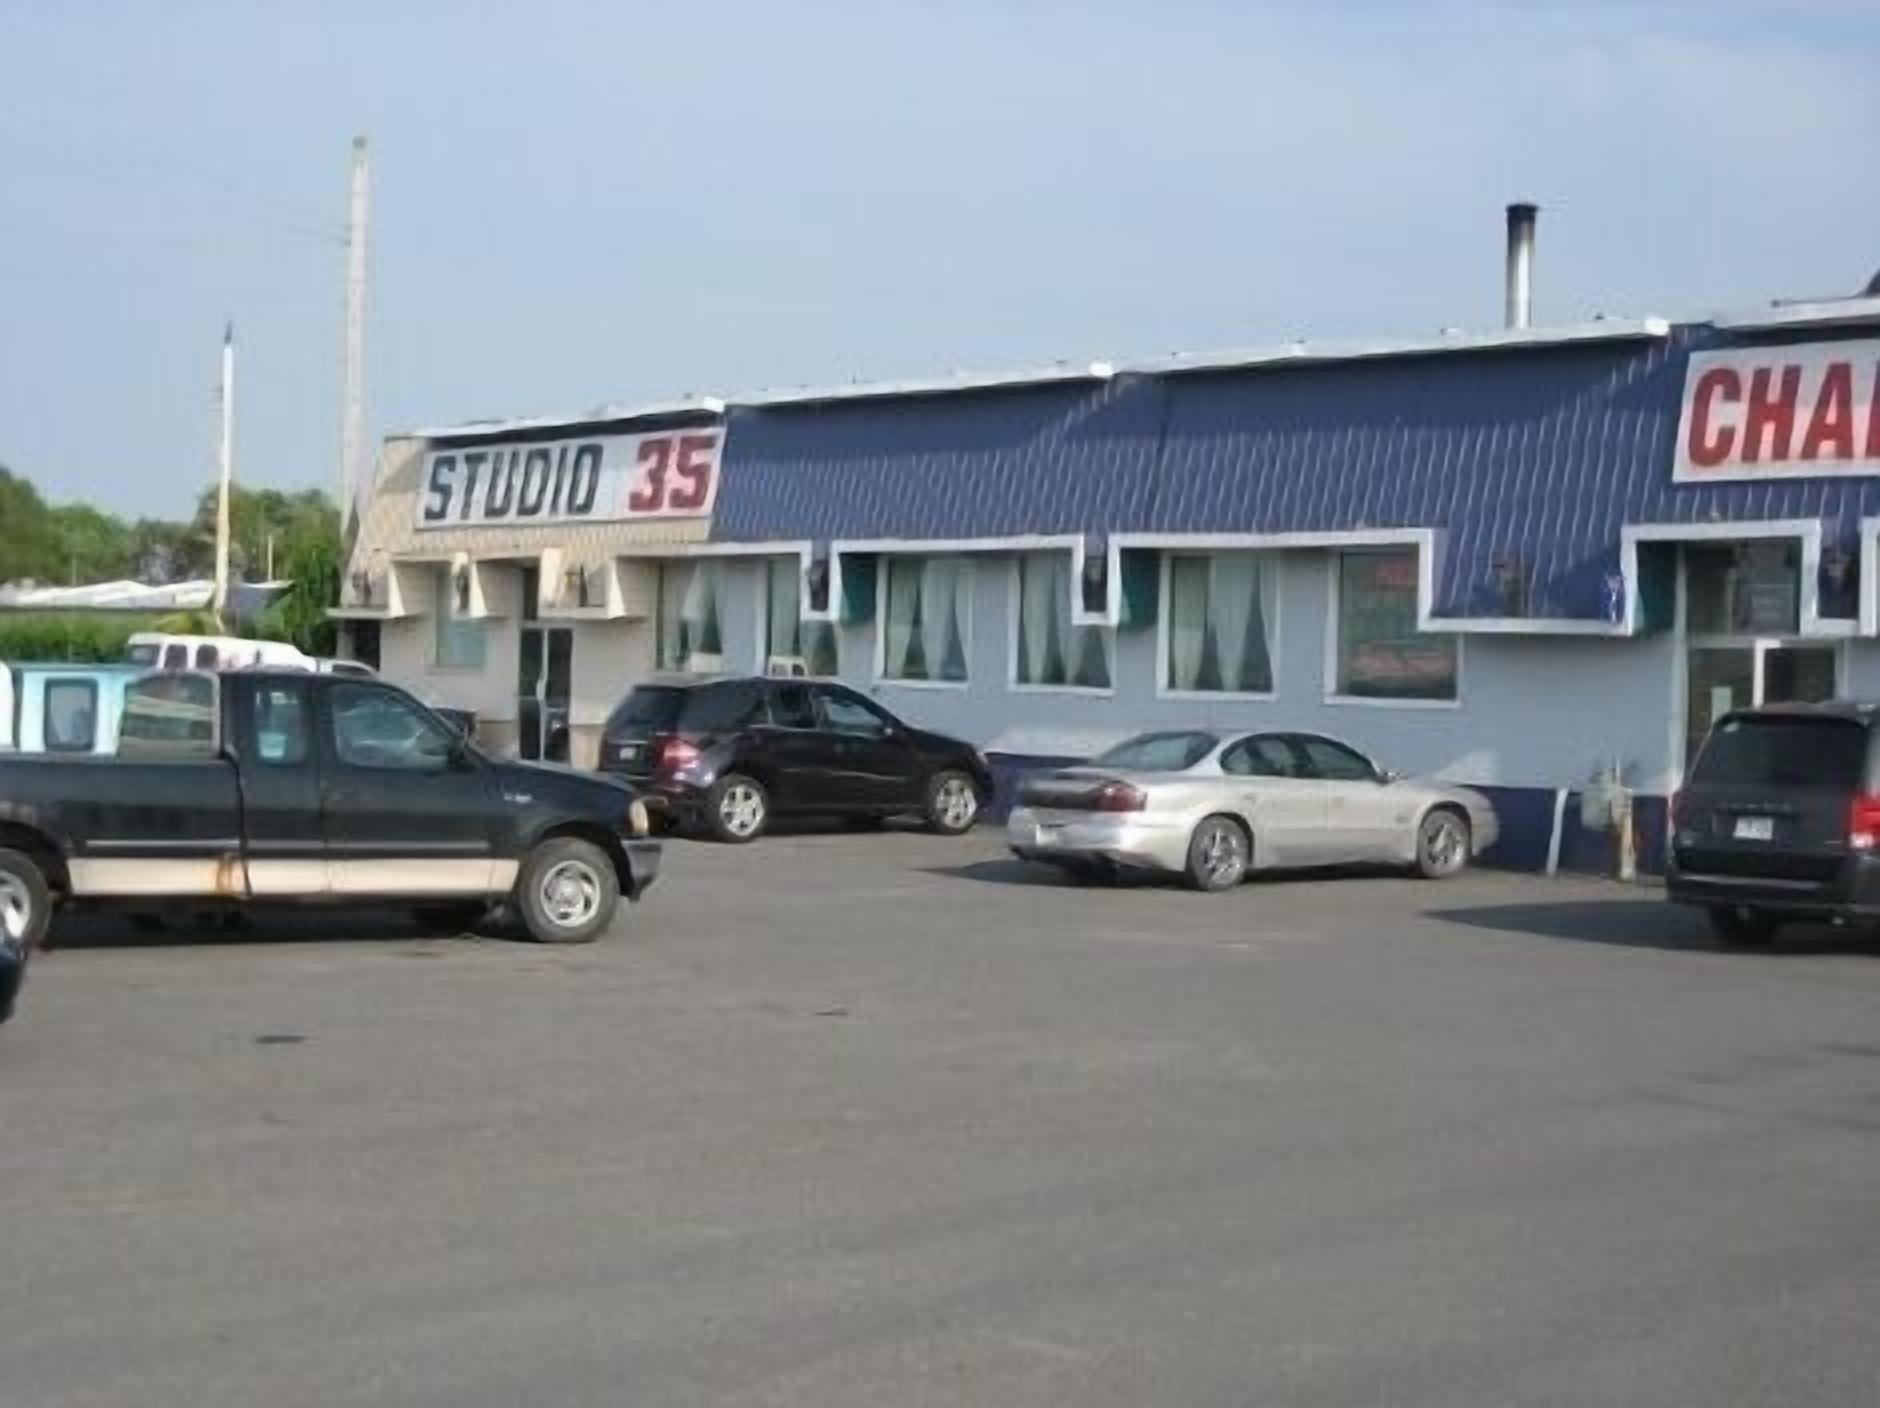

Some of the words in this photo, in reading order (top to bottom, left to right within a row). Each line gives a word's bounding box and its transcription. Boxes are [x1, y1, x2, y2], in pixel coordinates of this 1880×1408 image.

[1688, 361, 1880, 466] CHA
[424, 444, 603, 519] STUDIO
[628, 435, 717, 512] 35
